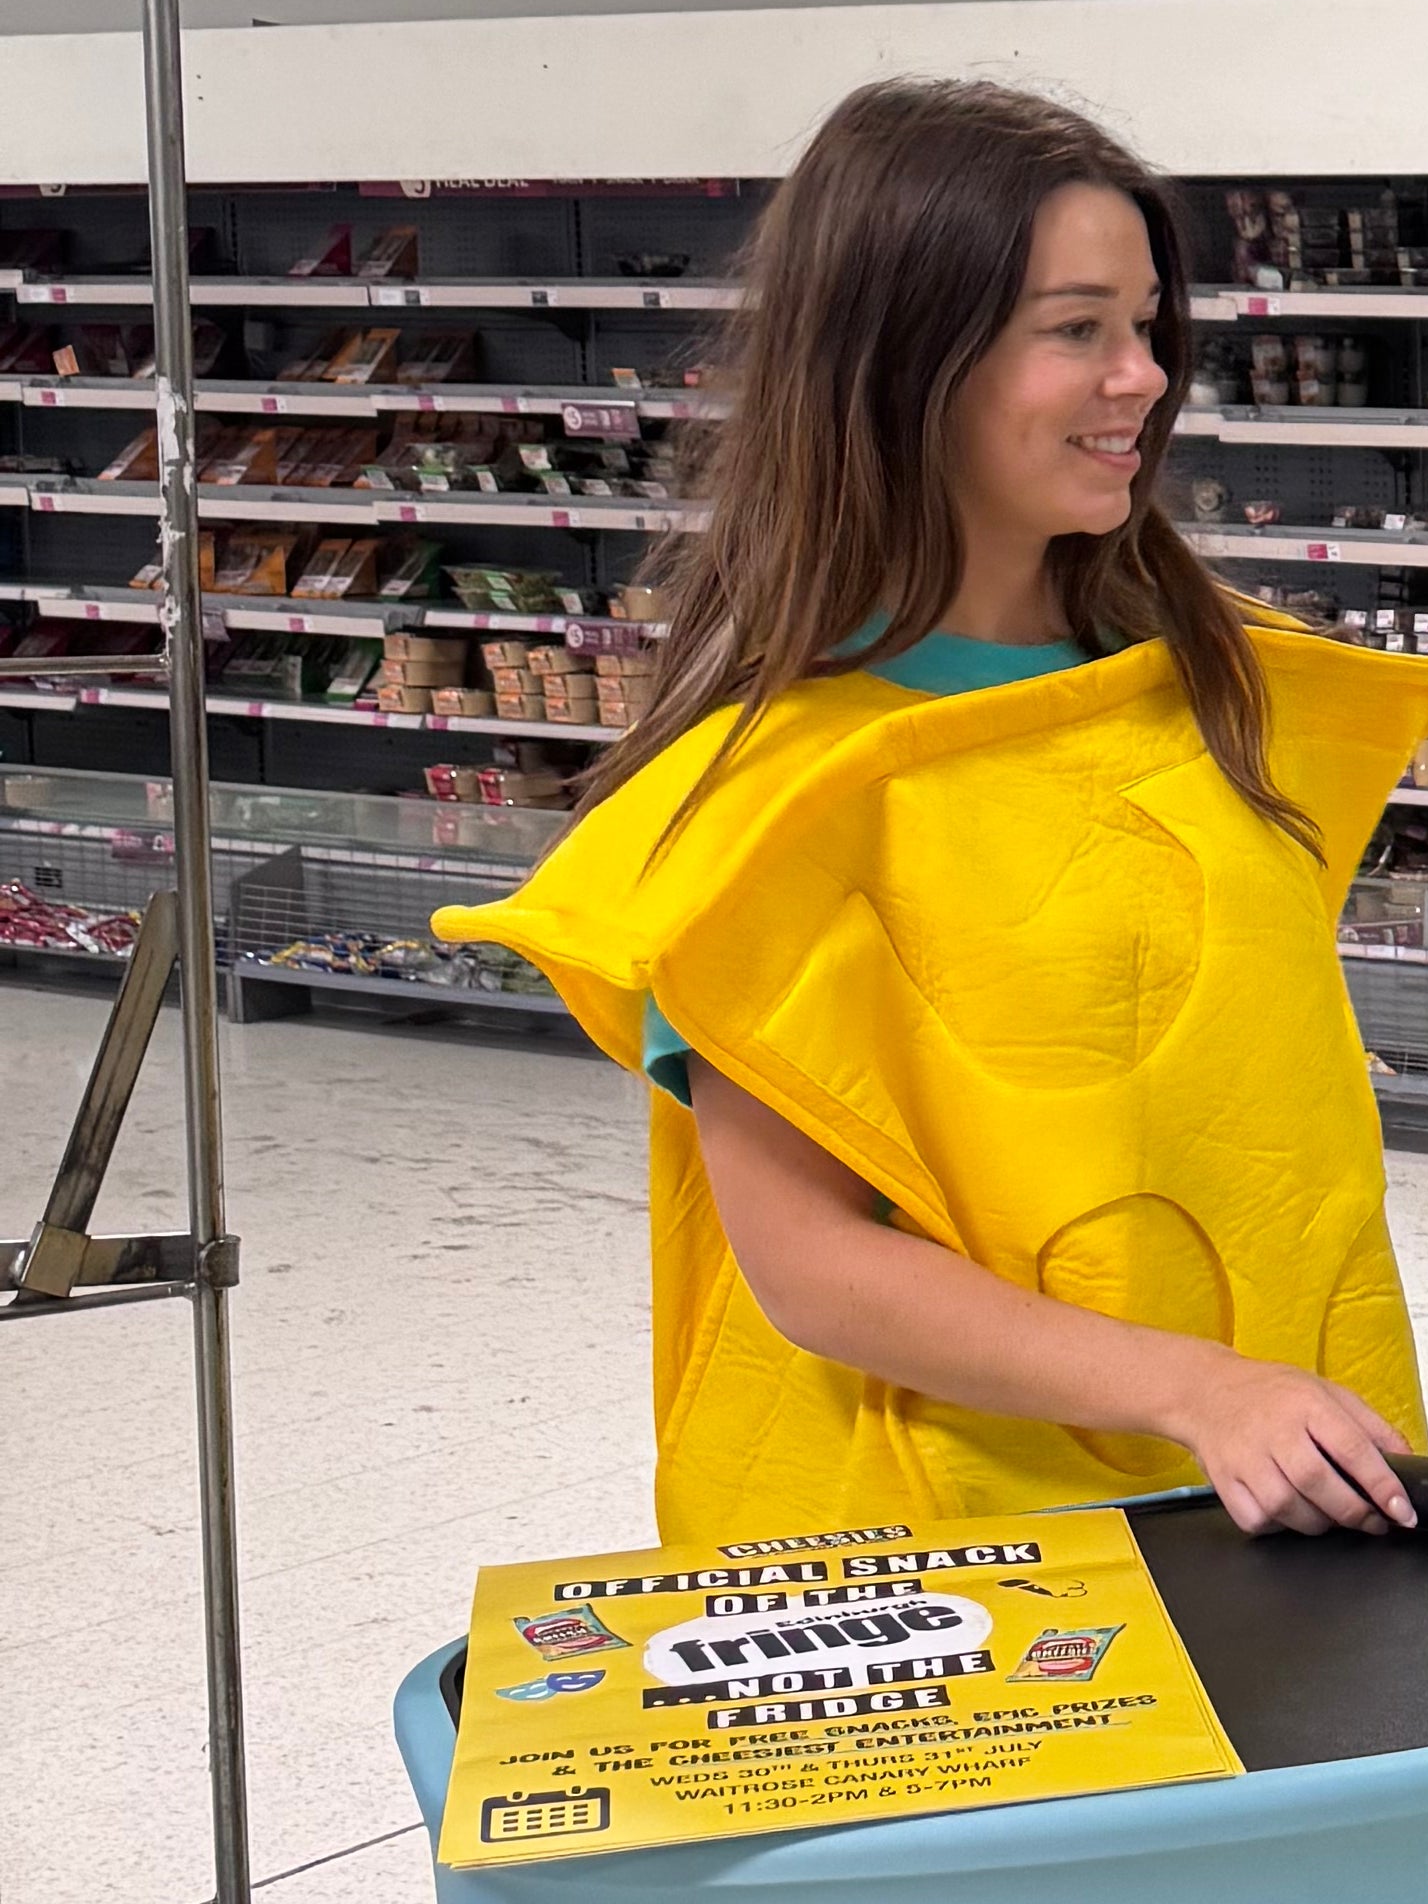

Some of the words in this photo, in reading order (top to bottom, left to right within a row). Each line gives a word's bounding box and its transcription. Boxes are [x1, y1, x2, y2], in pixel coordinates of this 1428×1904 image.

[562, 1562, 824, 1599] OFFICIAL
[849, 1544, 1037, 1576] SNACK
[713, 1594, 780, 1615] OF
[808, 1582, 919, 1607] THE
[669, 1604, 963, 1672] fringe
[871, 1653, 992, 1684] THE
[500, 1749, 575, 1766] JOIN
[589, 1743, 635, 1757] US
[650, 1737, 712, 1753] FOR
[728, 1730, 809, 1748] FREE
[973, 1706, 1039, 1723] EPIC
[1052, 1694, 1158, 1716] PRIZES
[716, 1688, 943, 1728] FRIDGE
[594, 1757, 654, 1774] THE
[668, 1741, 841, 1767] CHEESIEST
[856, 1713, 1112, 1750] ENTERTAINMENT
[650, 1771, 730, 1788] WEDS
[827, 1752, 916, 1772] THURS
[985, 1739, 1043, 1756] JULY
[675, 1776, 815, 1802] WAITROSE
[824, 1765, 930, 1789] CANARY
[938, 1756, 1032, 1776] WHARF
[724, 1788, 868, 1816] 11:30-2PM
[907, 1776, 993, 1795] 5-7PM
